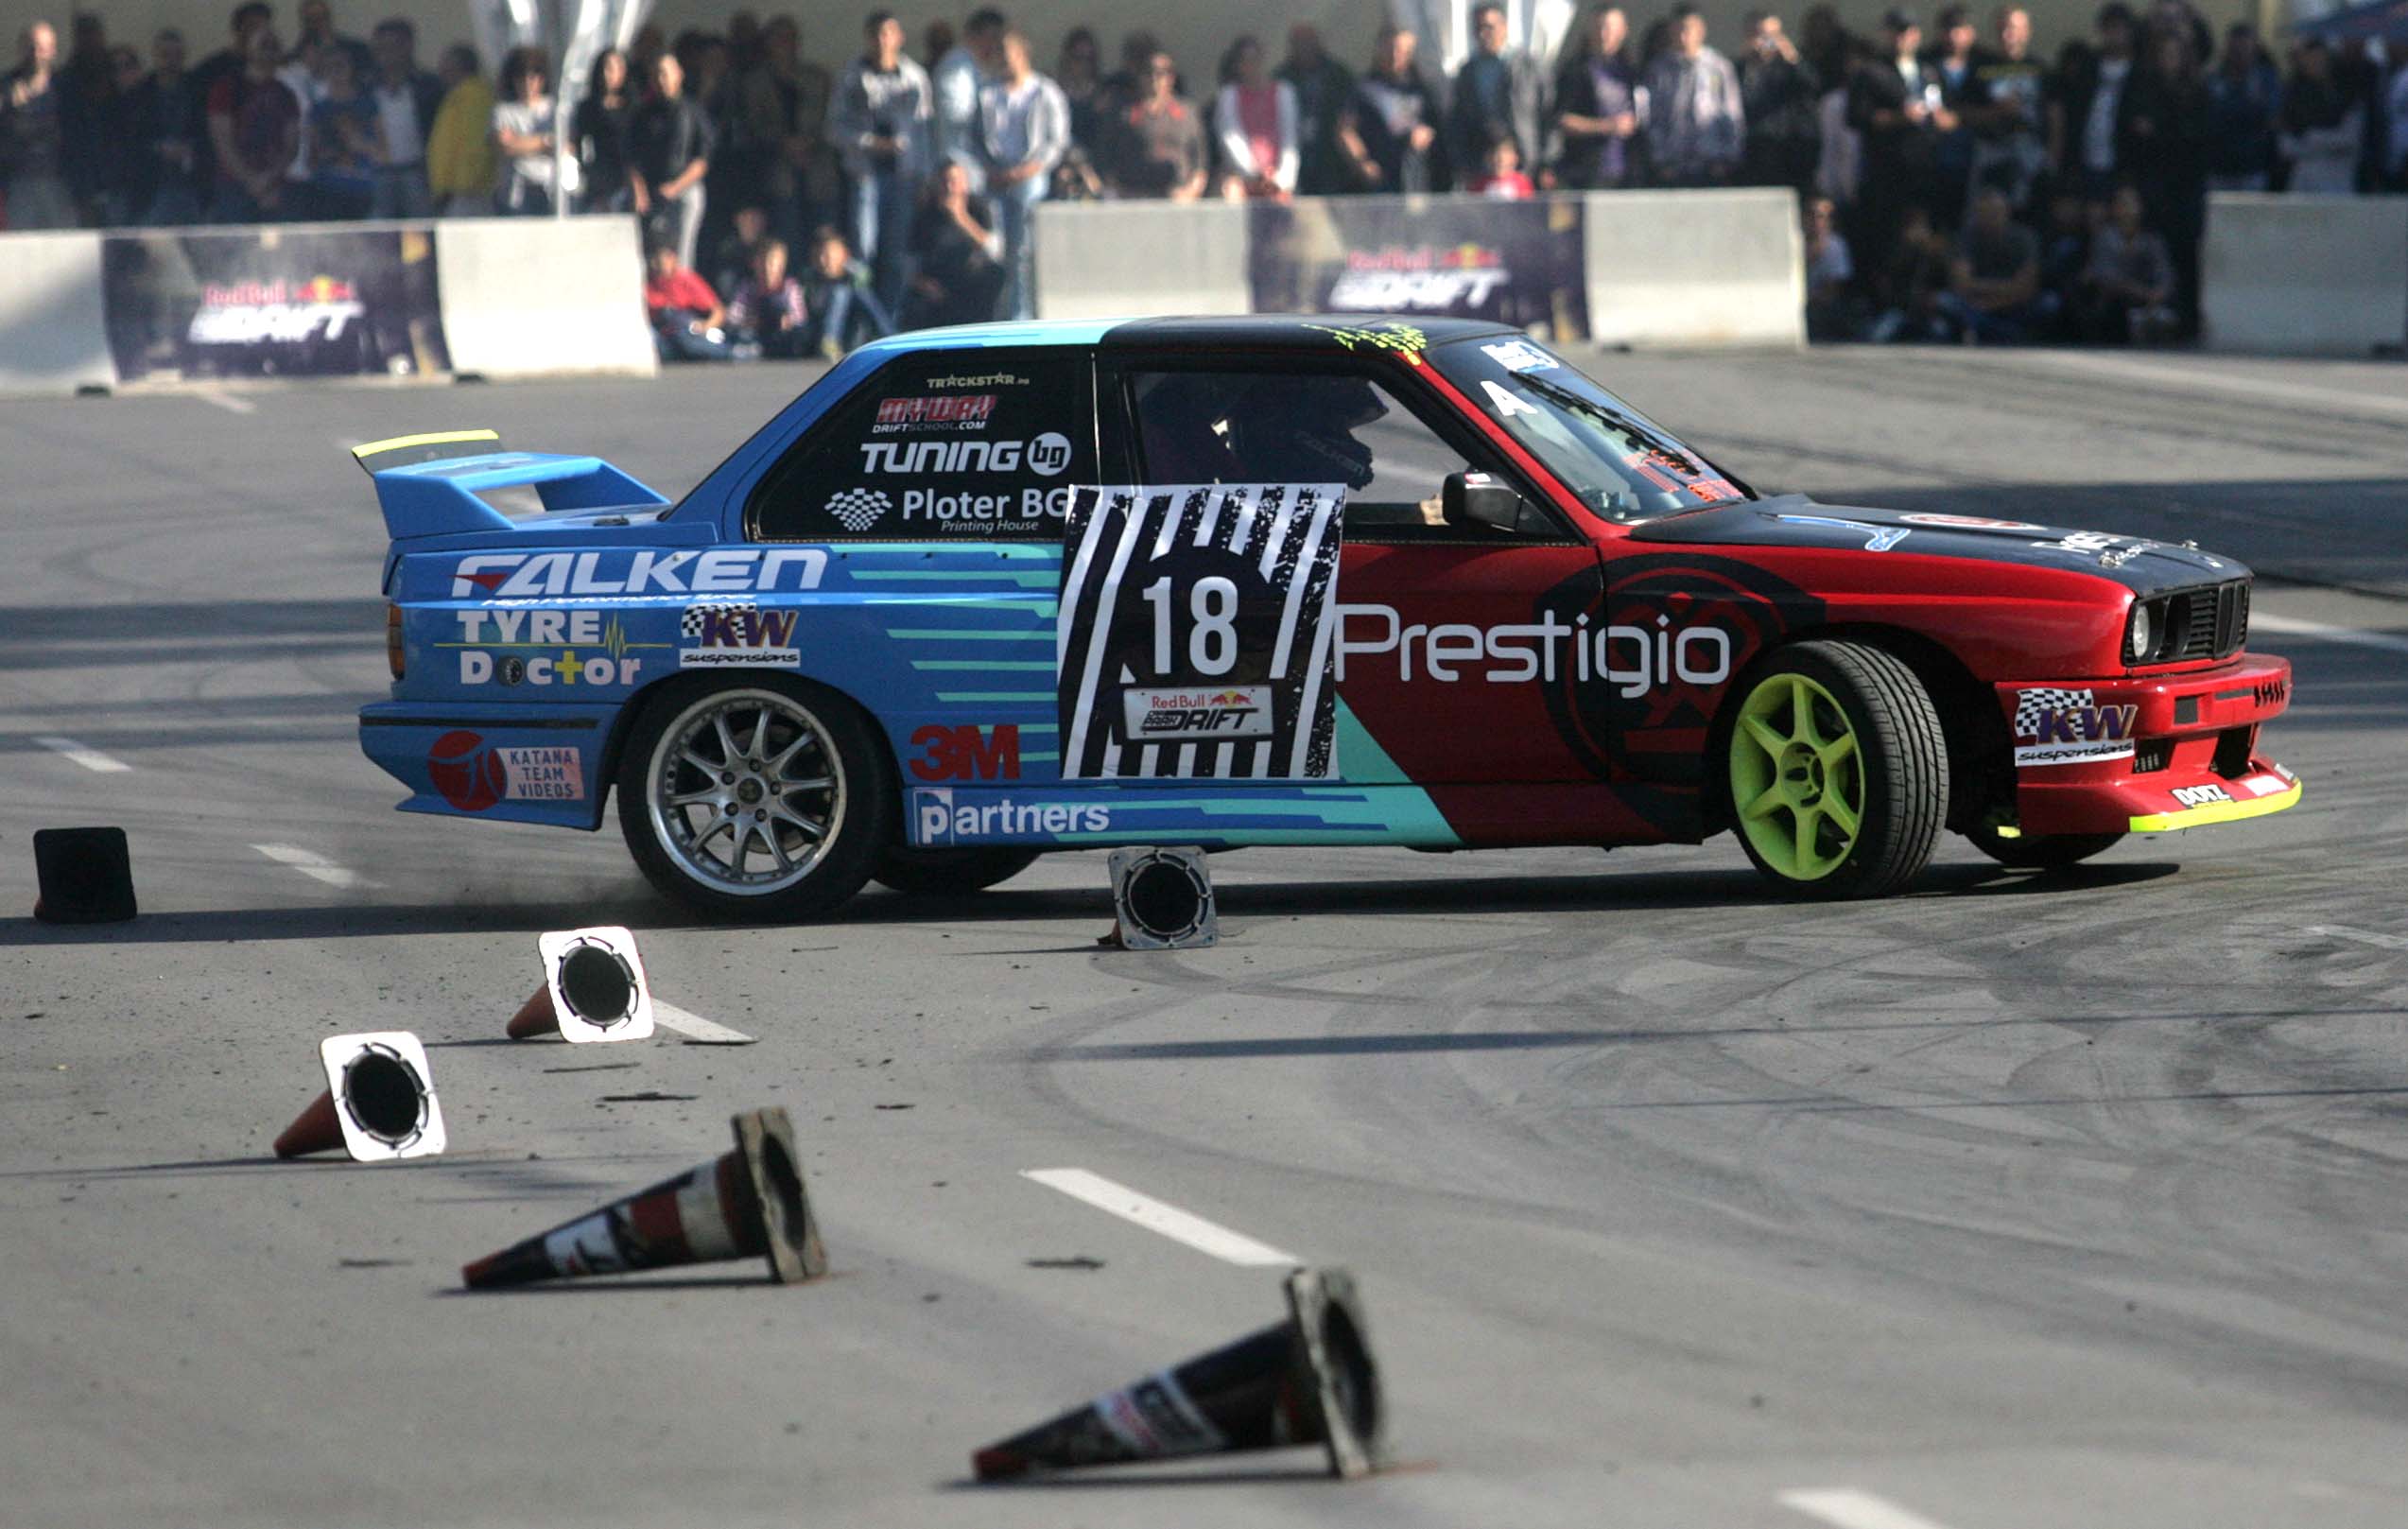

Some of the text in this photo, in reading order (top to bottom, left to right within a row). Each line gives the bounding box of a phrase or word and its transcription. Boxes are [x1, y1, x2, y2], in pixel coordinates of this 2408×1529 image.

[859, 441, 1023, 474] TUNING
[902, 488, 1069, 520] Ploter BG
[941, 519, 1039, 534] Printing House
[450, 549, 827, 597] FALKEN
[457, 610, 601, 644] TYRE
[701, 609, 800, 648] KW
[1142, 575, 1239, 676] 18
[682, 652, 799, 665] suspensions
[1334, 602, 1731, 699] Prestigio
[1152, 694, 1205, 709] Red Bull
[1141, 708, 1258, 731] DRIFT
[2036, 704, 2139, 745] KW
[510, 748, 573, 766] KATANA
[909, 723, 1021, 782] 3M
[2017, 741, 2135, 762] suspensions
[518, 782, 575, 798] VIDEOS
[522, 767, 565, 783] TEAM
[920, 799, 1111, 845] partners
